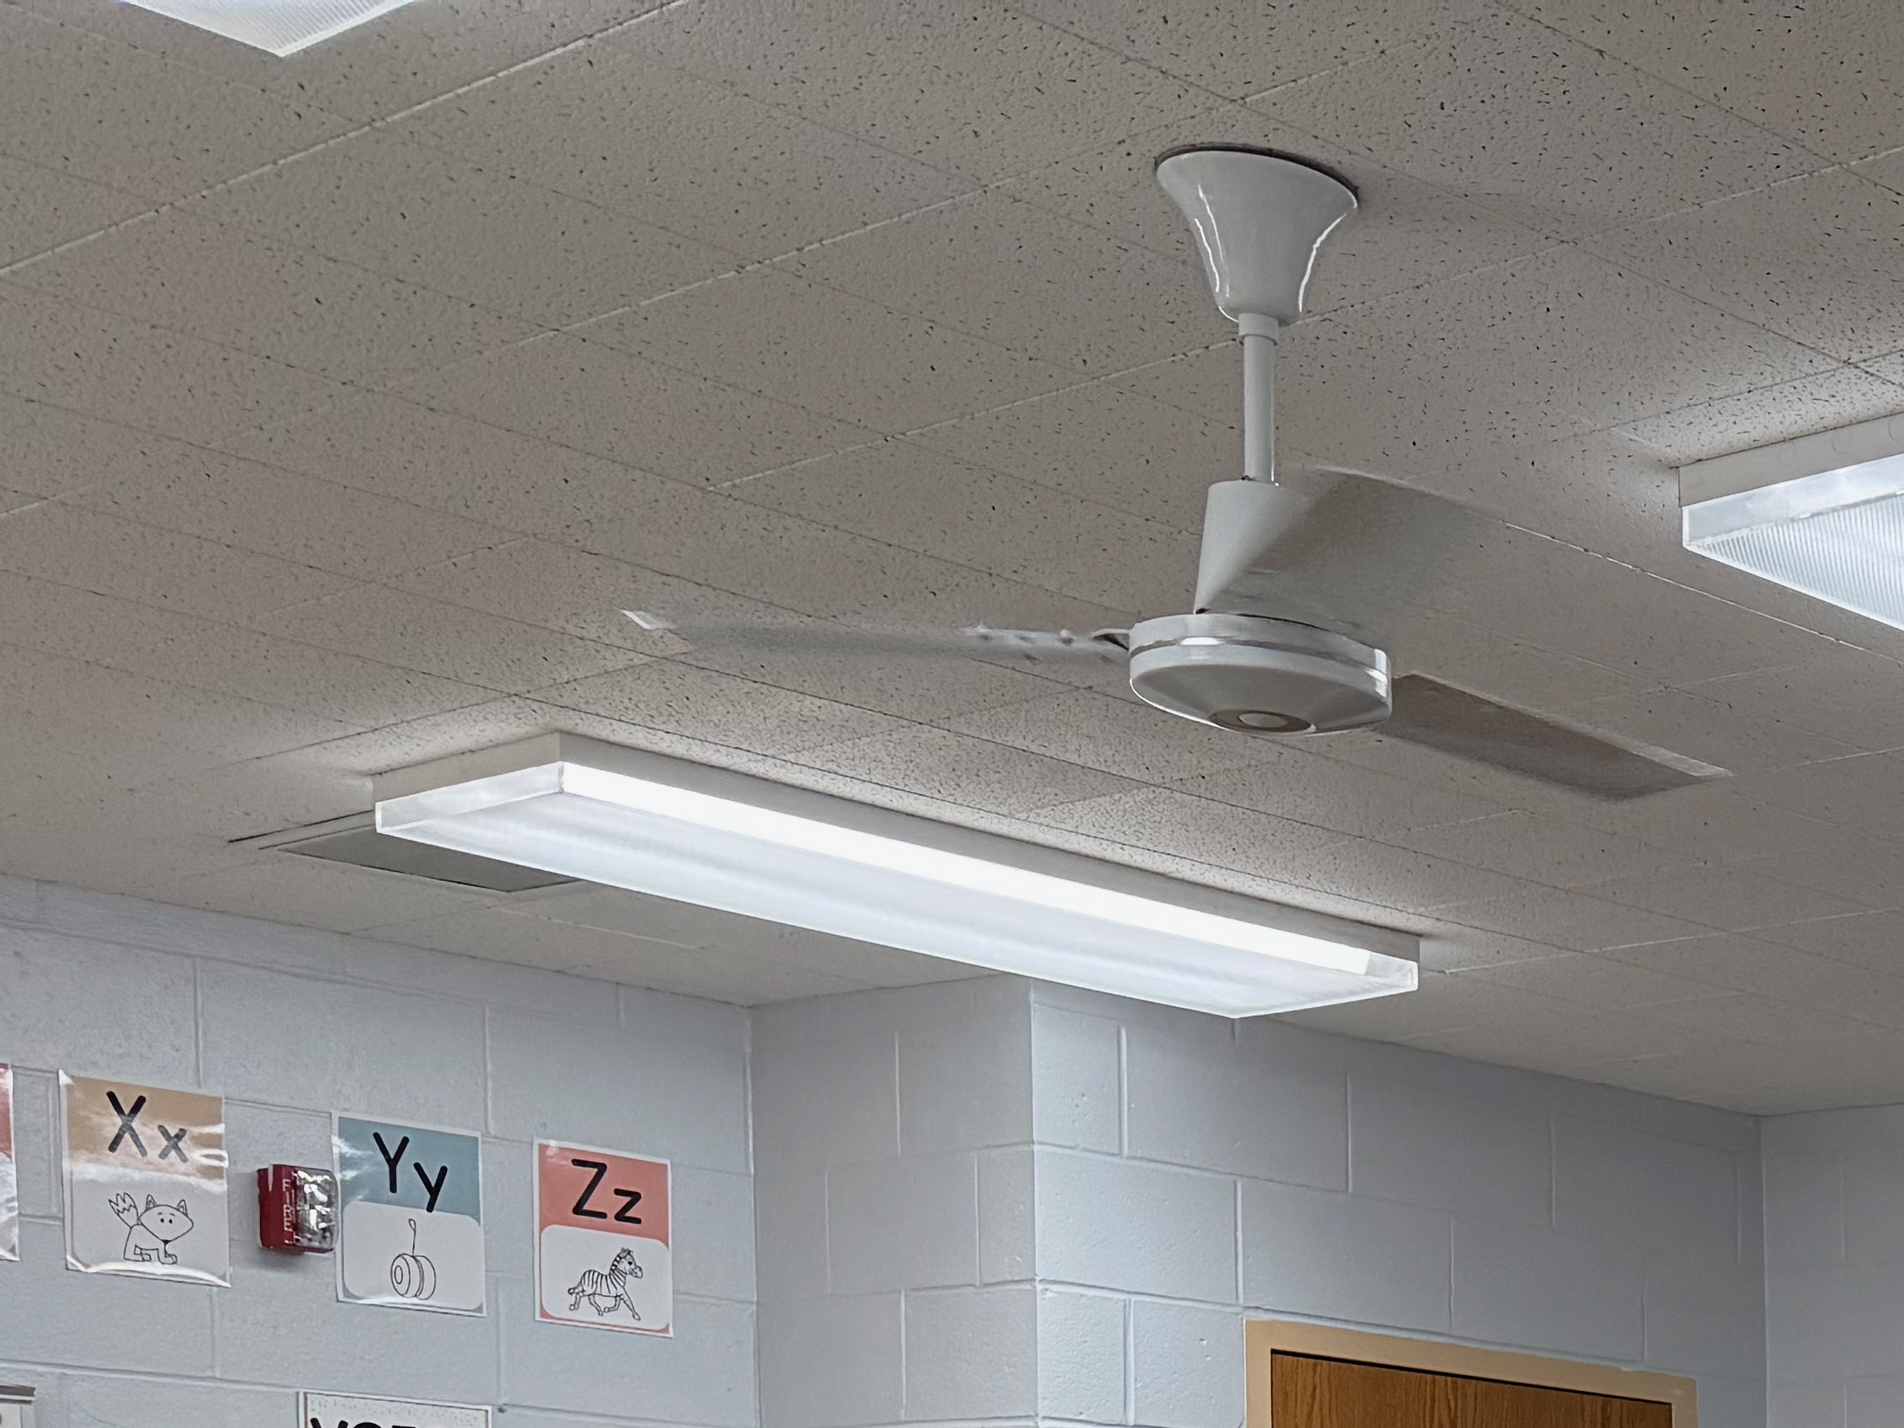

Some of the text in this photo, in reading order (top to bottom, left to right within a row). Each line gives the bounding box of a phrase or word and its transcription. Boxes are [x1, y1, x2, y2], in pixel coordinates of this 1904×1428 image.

[107, 1091, 188, 1163] Xx
[373, 1132, 448, 1212] Yy
[571, 1159, 643, 1225] Zz
